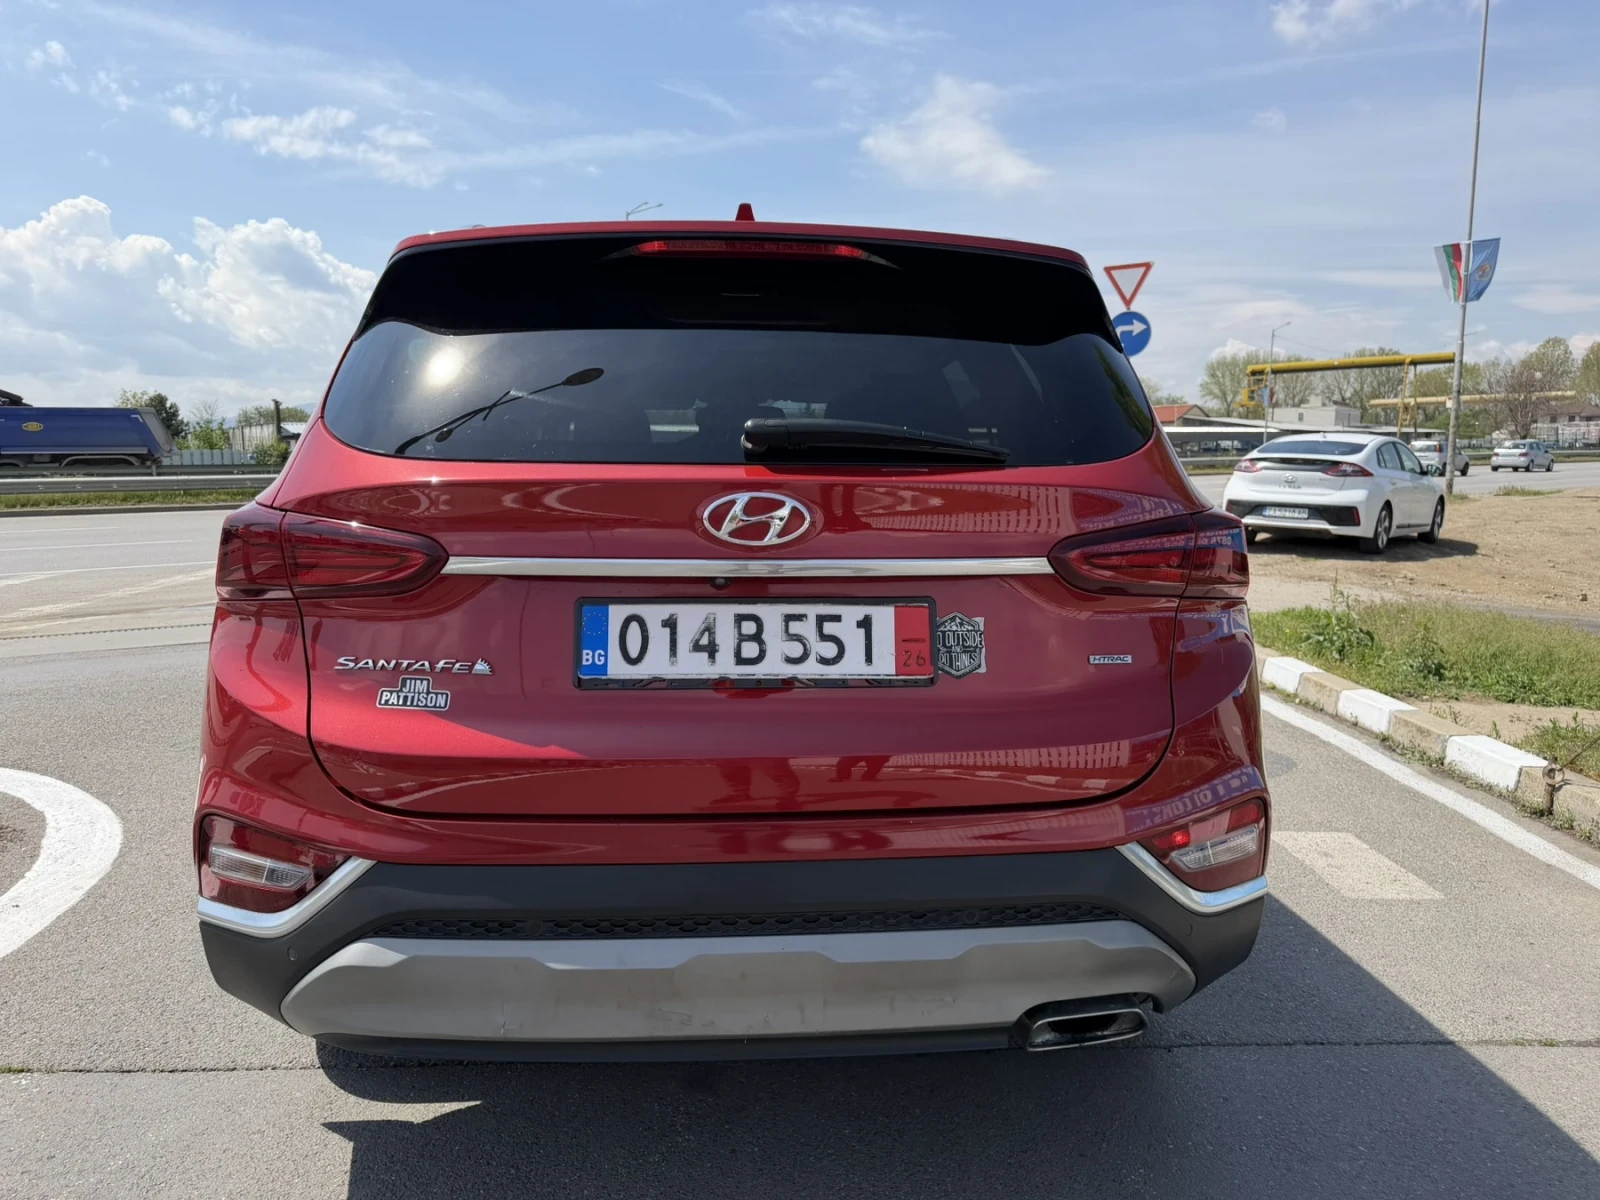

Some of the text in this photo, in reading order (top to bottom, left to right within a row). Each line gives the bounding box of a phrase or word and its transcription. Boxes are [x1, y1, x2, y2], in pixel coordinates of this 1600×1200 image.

[945, 631, 983, 648] OUTSIDE
[582, 649, 605, 665] BG
[951, 645, 964, 653] AND
[902, 650, 926, 668] 26
[938, 652, 978, 670] DO THINGS
[1091, 655, 1130, 663] HTRAC
[402, 679, 428, 693] JIM
[380, 691, 447, 707] PATTISON
